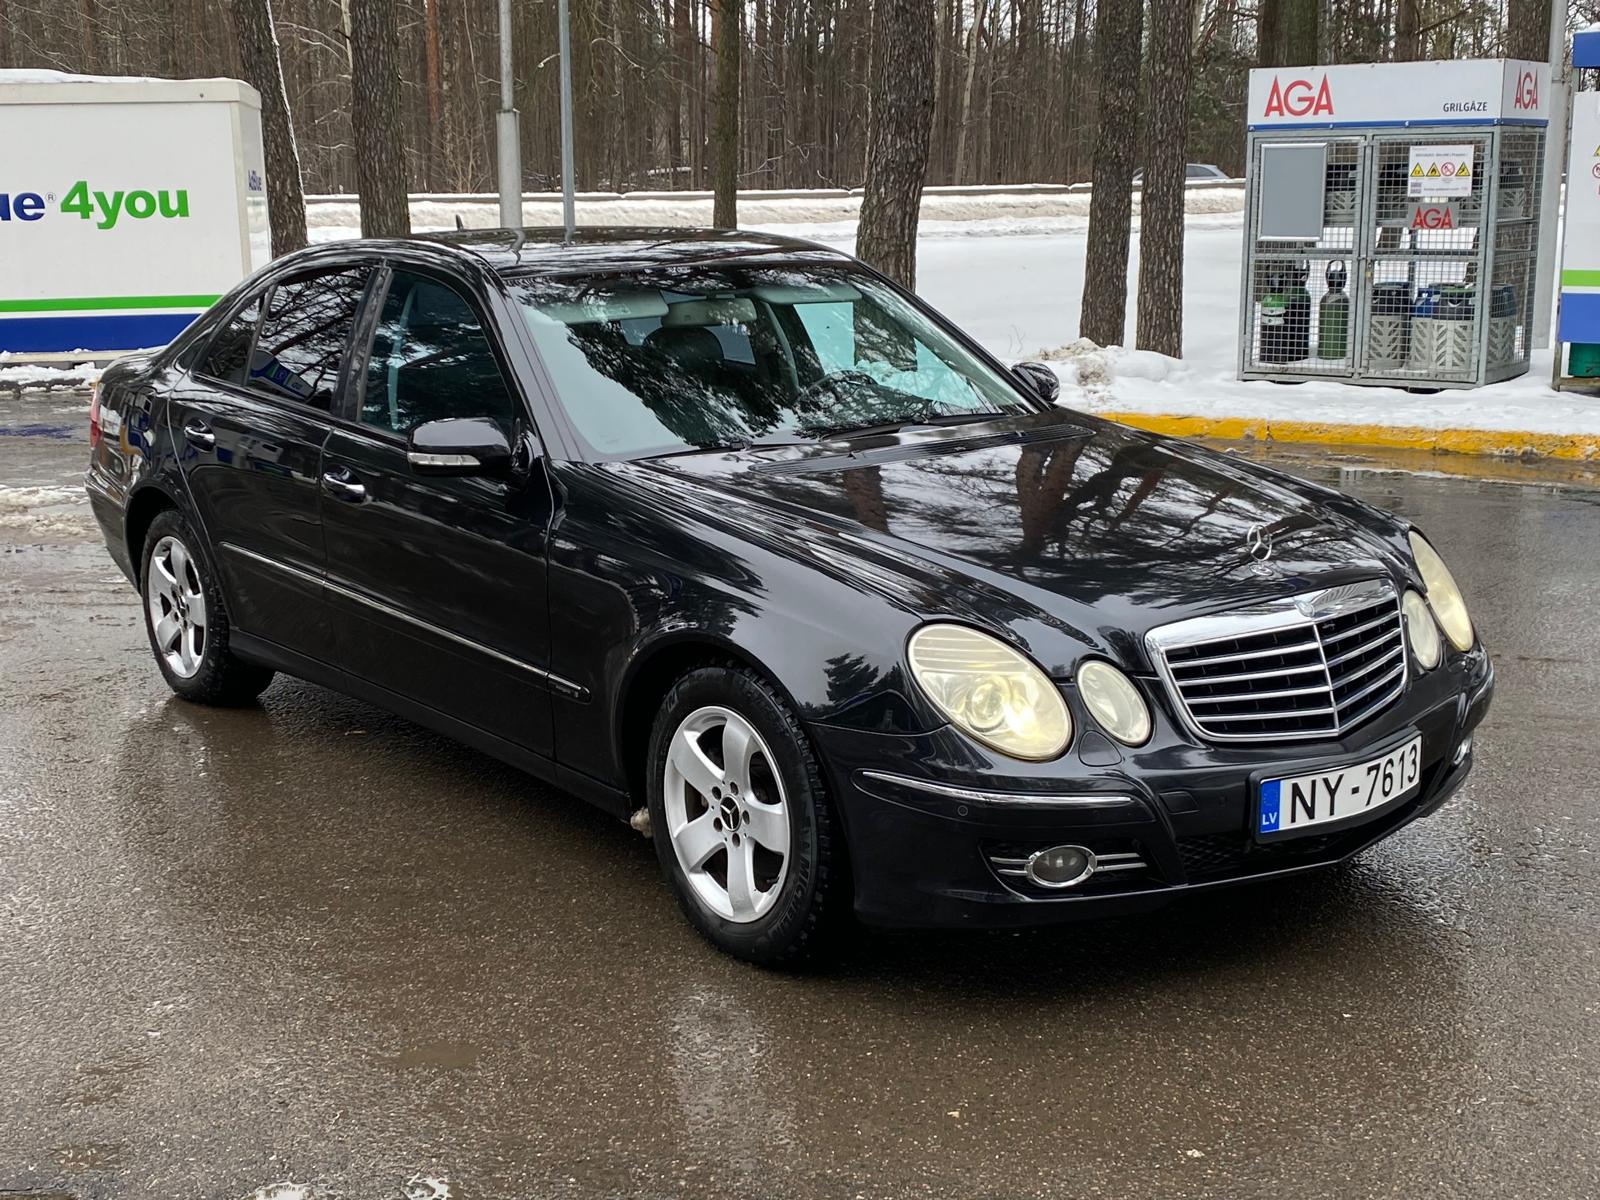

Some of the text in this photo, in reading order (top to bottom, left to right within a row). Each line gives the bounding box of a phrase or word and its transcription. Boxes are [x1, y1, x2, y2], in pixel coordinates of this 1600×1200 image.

[1264, 73, 1334, 117] AGA
[1514, 64, 1538, 110] AGA
[60, 180, 189, 230] 4you
[1412, 206, 1453, 229] AGA
[1290, 743, 1417, 823] NY-7613
[1262, 812, 1277, 825] LV
